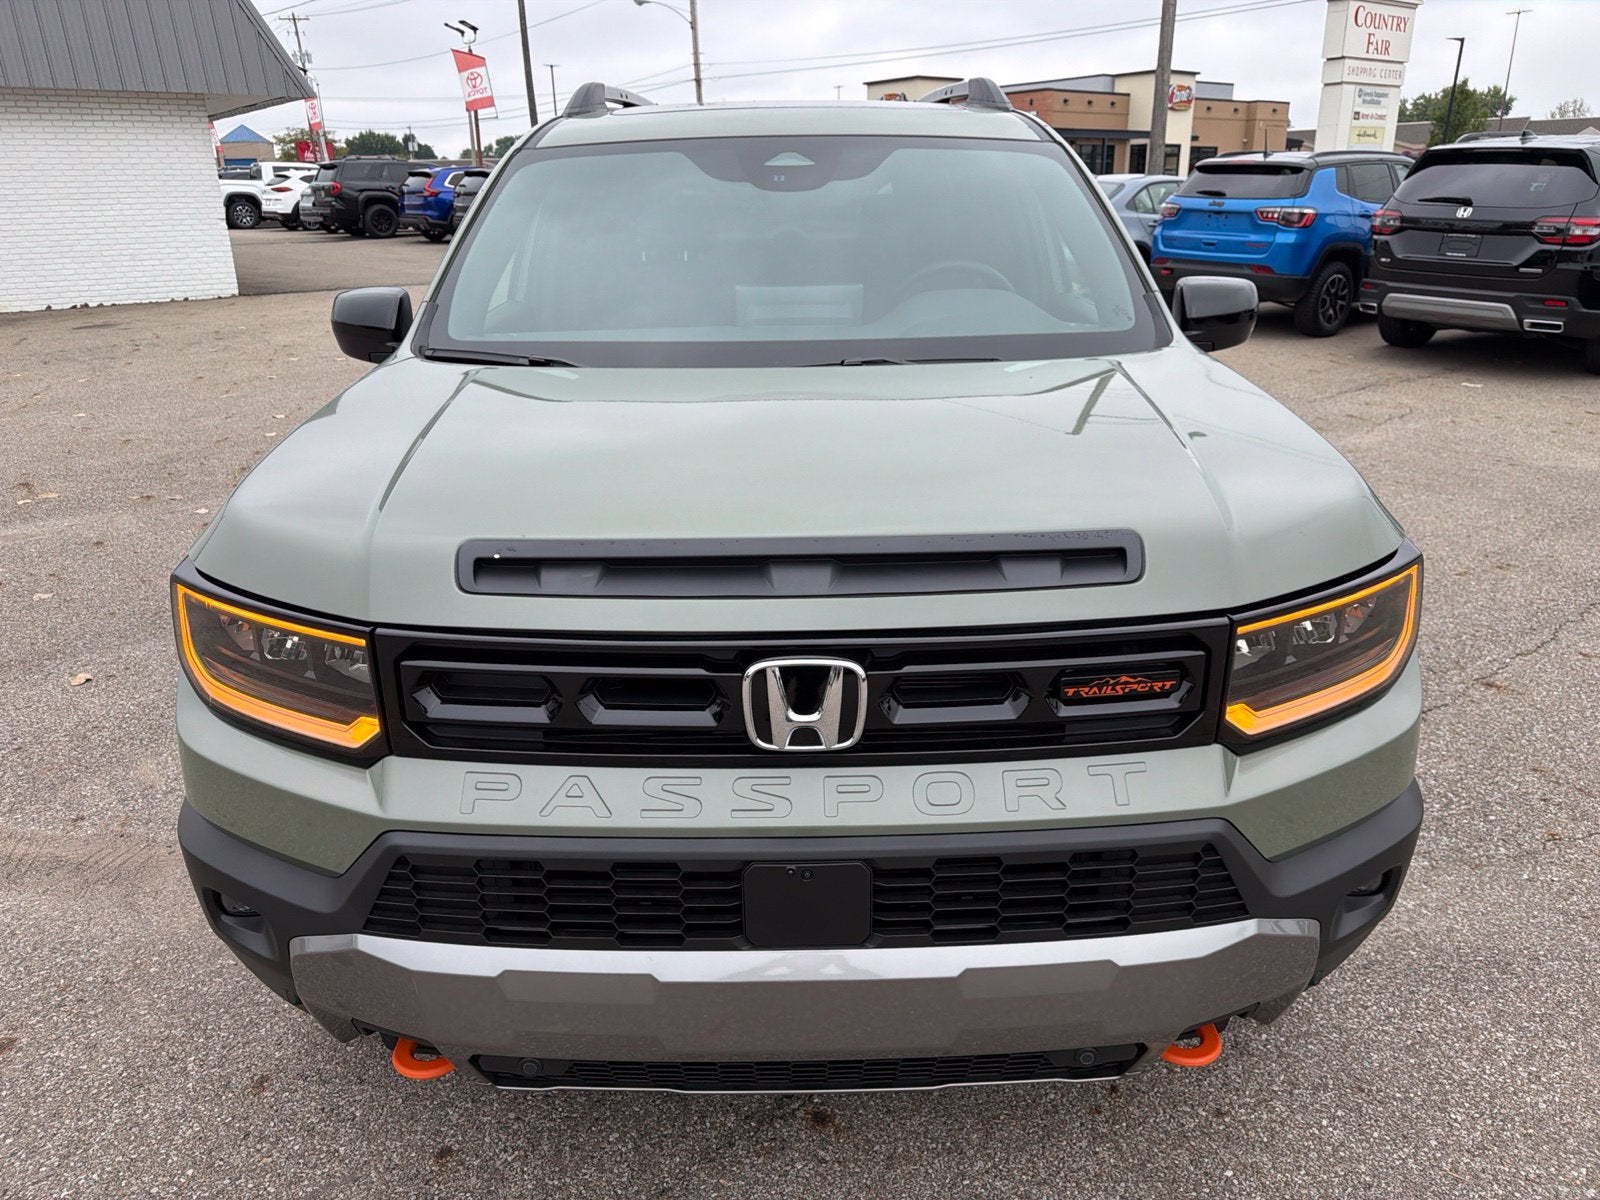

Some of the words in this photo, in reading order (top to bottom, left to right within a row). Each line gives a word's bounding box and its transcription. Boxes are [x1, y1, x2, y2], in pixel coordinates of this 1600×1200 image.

[1354, 5, 1409, 33] COUNTRY
[1365, 33, 1391, 56] FAIR
[1347, 65, 1377, 79] SHOPPING
[1379, 68, 1402, 80] CENTER
[1063, 681, 1177, 698] TRAILSPORT
[458, 760, 1148, 820] PASSPORT
